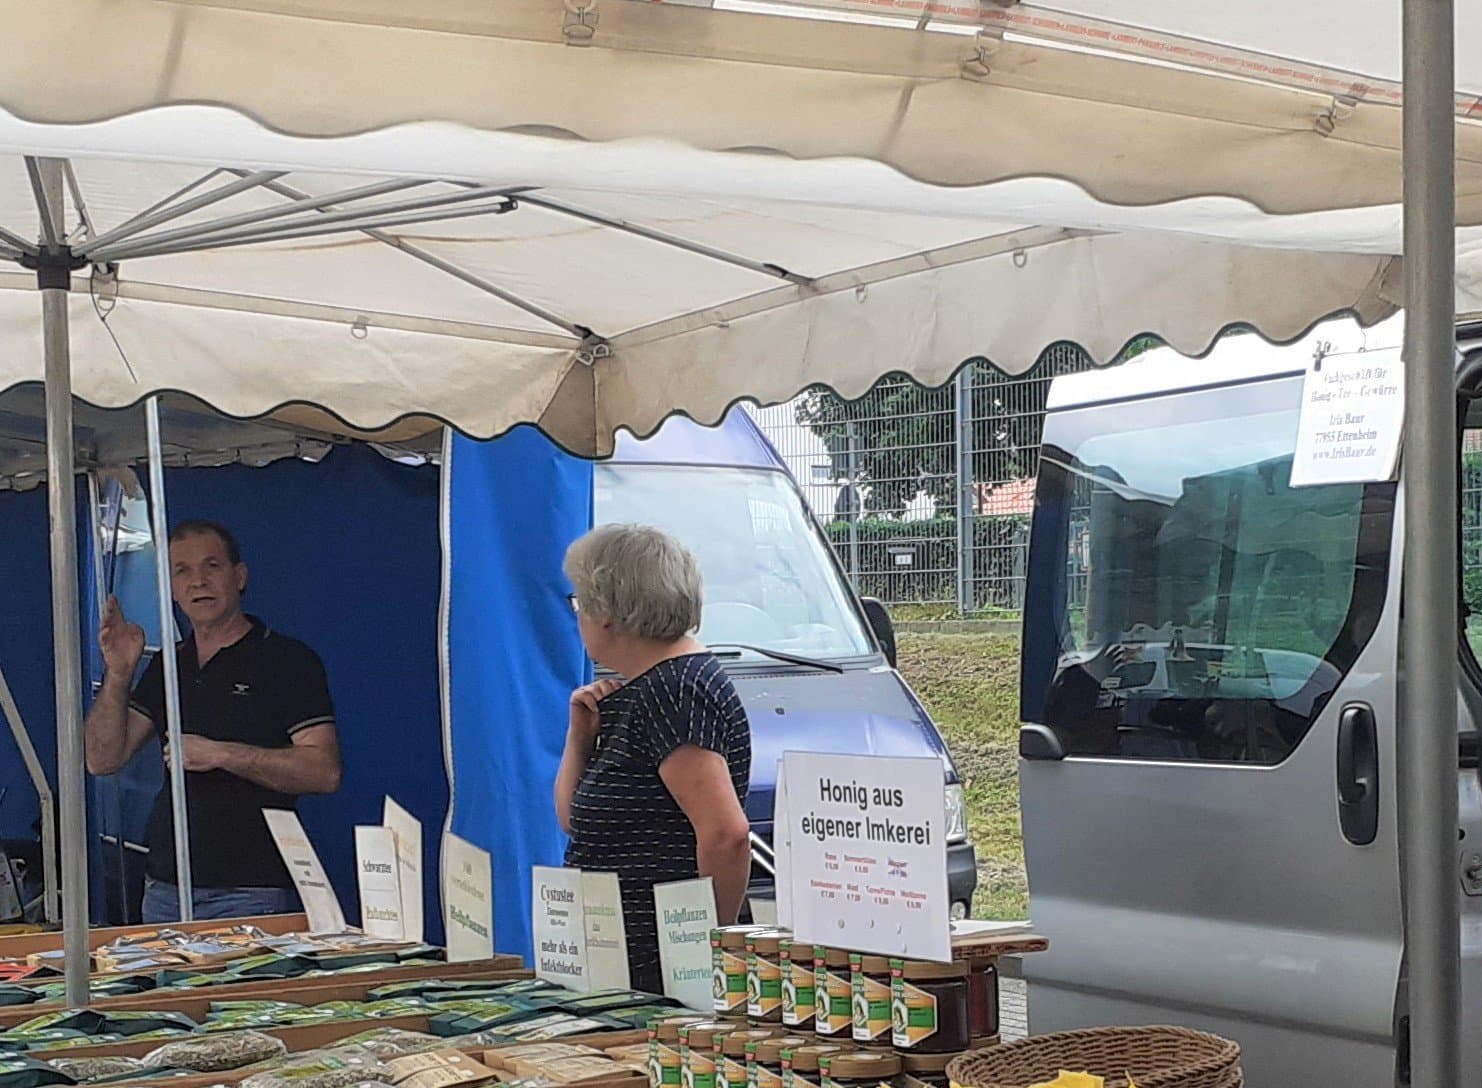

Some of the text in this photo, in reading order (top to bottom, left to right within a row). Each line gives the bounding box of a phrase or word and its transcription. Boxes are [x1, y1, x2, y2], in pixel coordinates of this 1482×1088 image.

[820, 778, 904, 810] Honig aus
[802, 812, 930, 845] eigener Imkerei
[541, 940, 557, 953] mehr
[558, 941, 568, 954] als
